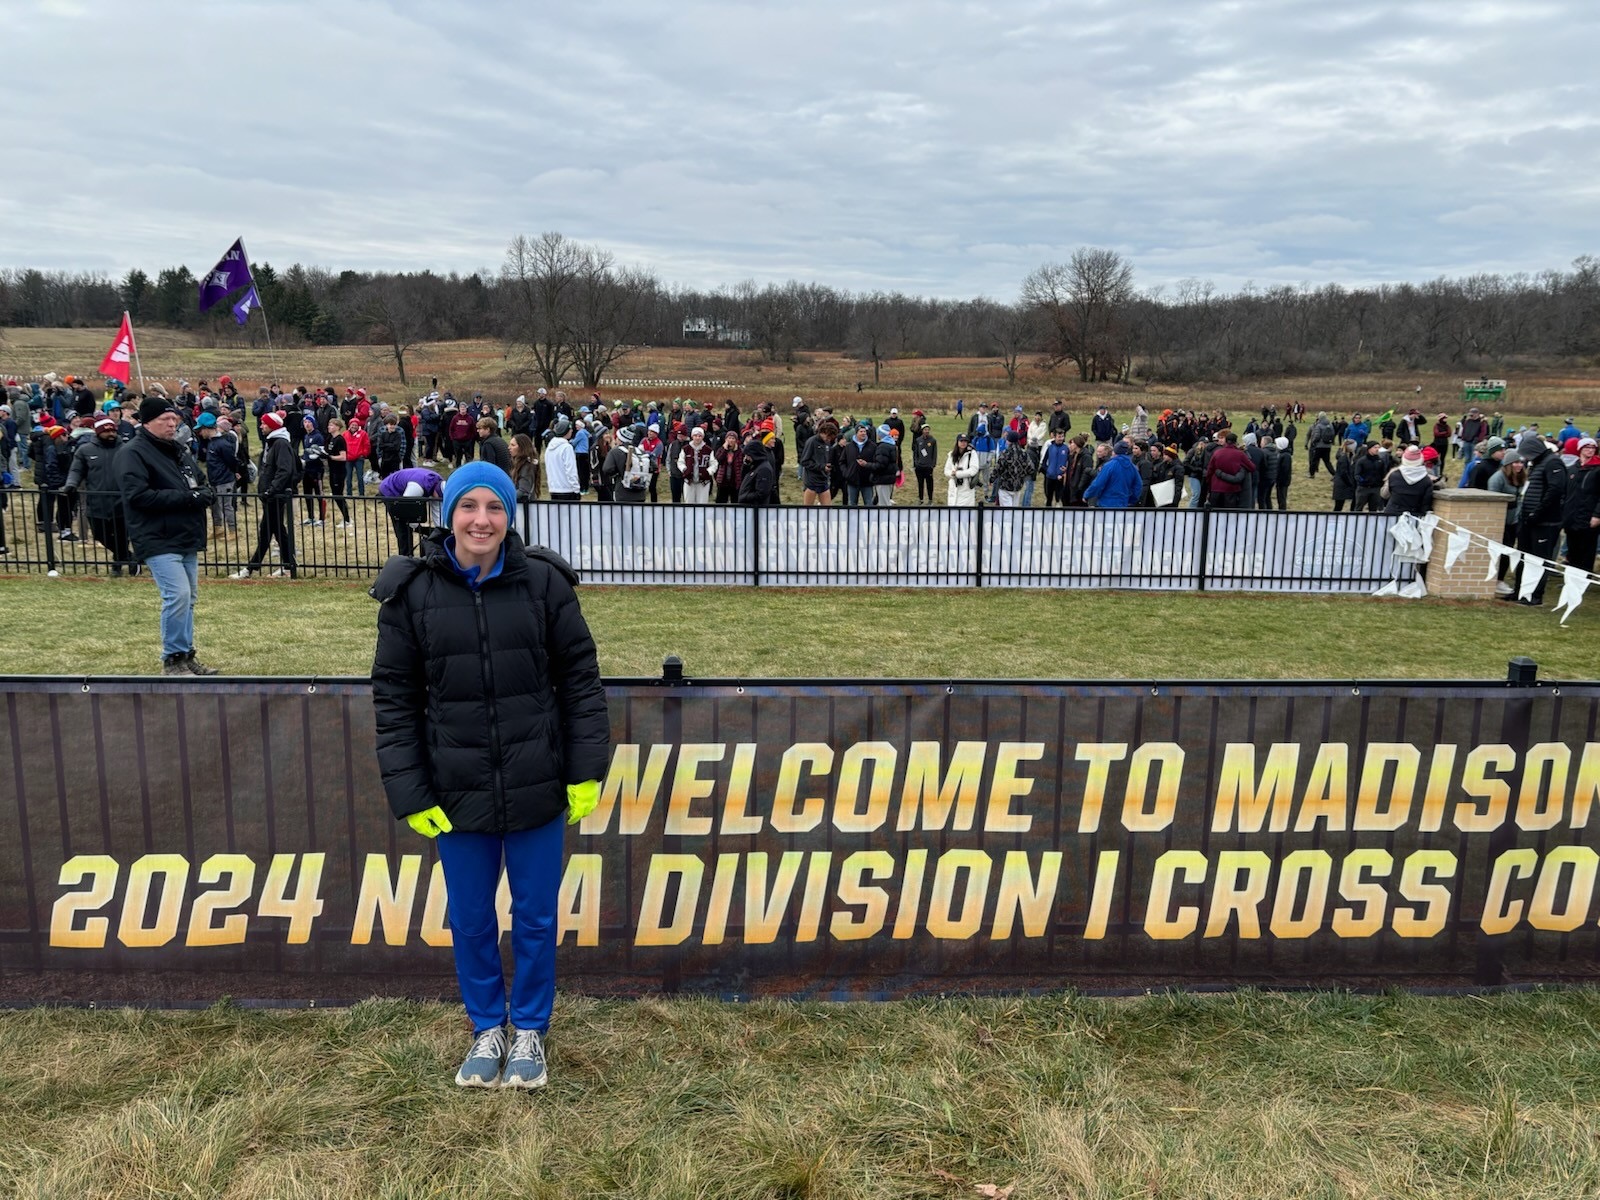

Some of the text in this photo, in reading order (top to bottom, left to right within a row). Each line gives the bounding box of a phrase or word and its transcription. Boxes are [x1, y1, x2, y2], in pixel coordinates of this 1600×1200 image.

[580, 741, 1045, 835] WELCOME
[1075, 741, 1186, 833] TO
[49, 852, 325, 948] 2024
[634, 849, 1063, 947] DIVISION
[1083, 850, 1120, 939] I
[1143, 848, 1459, 939] CROSS
[1480, 845, 1600, 936] CO
